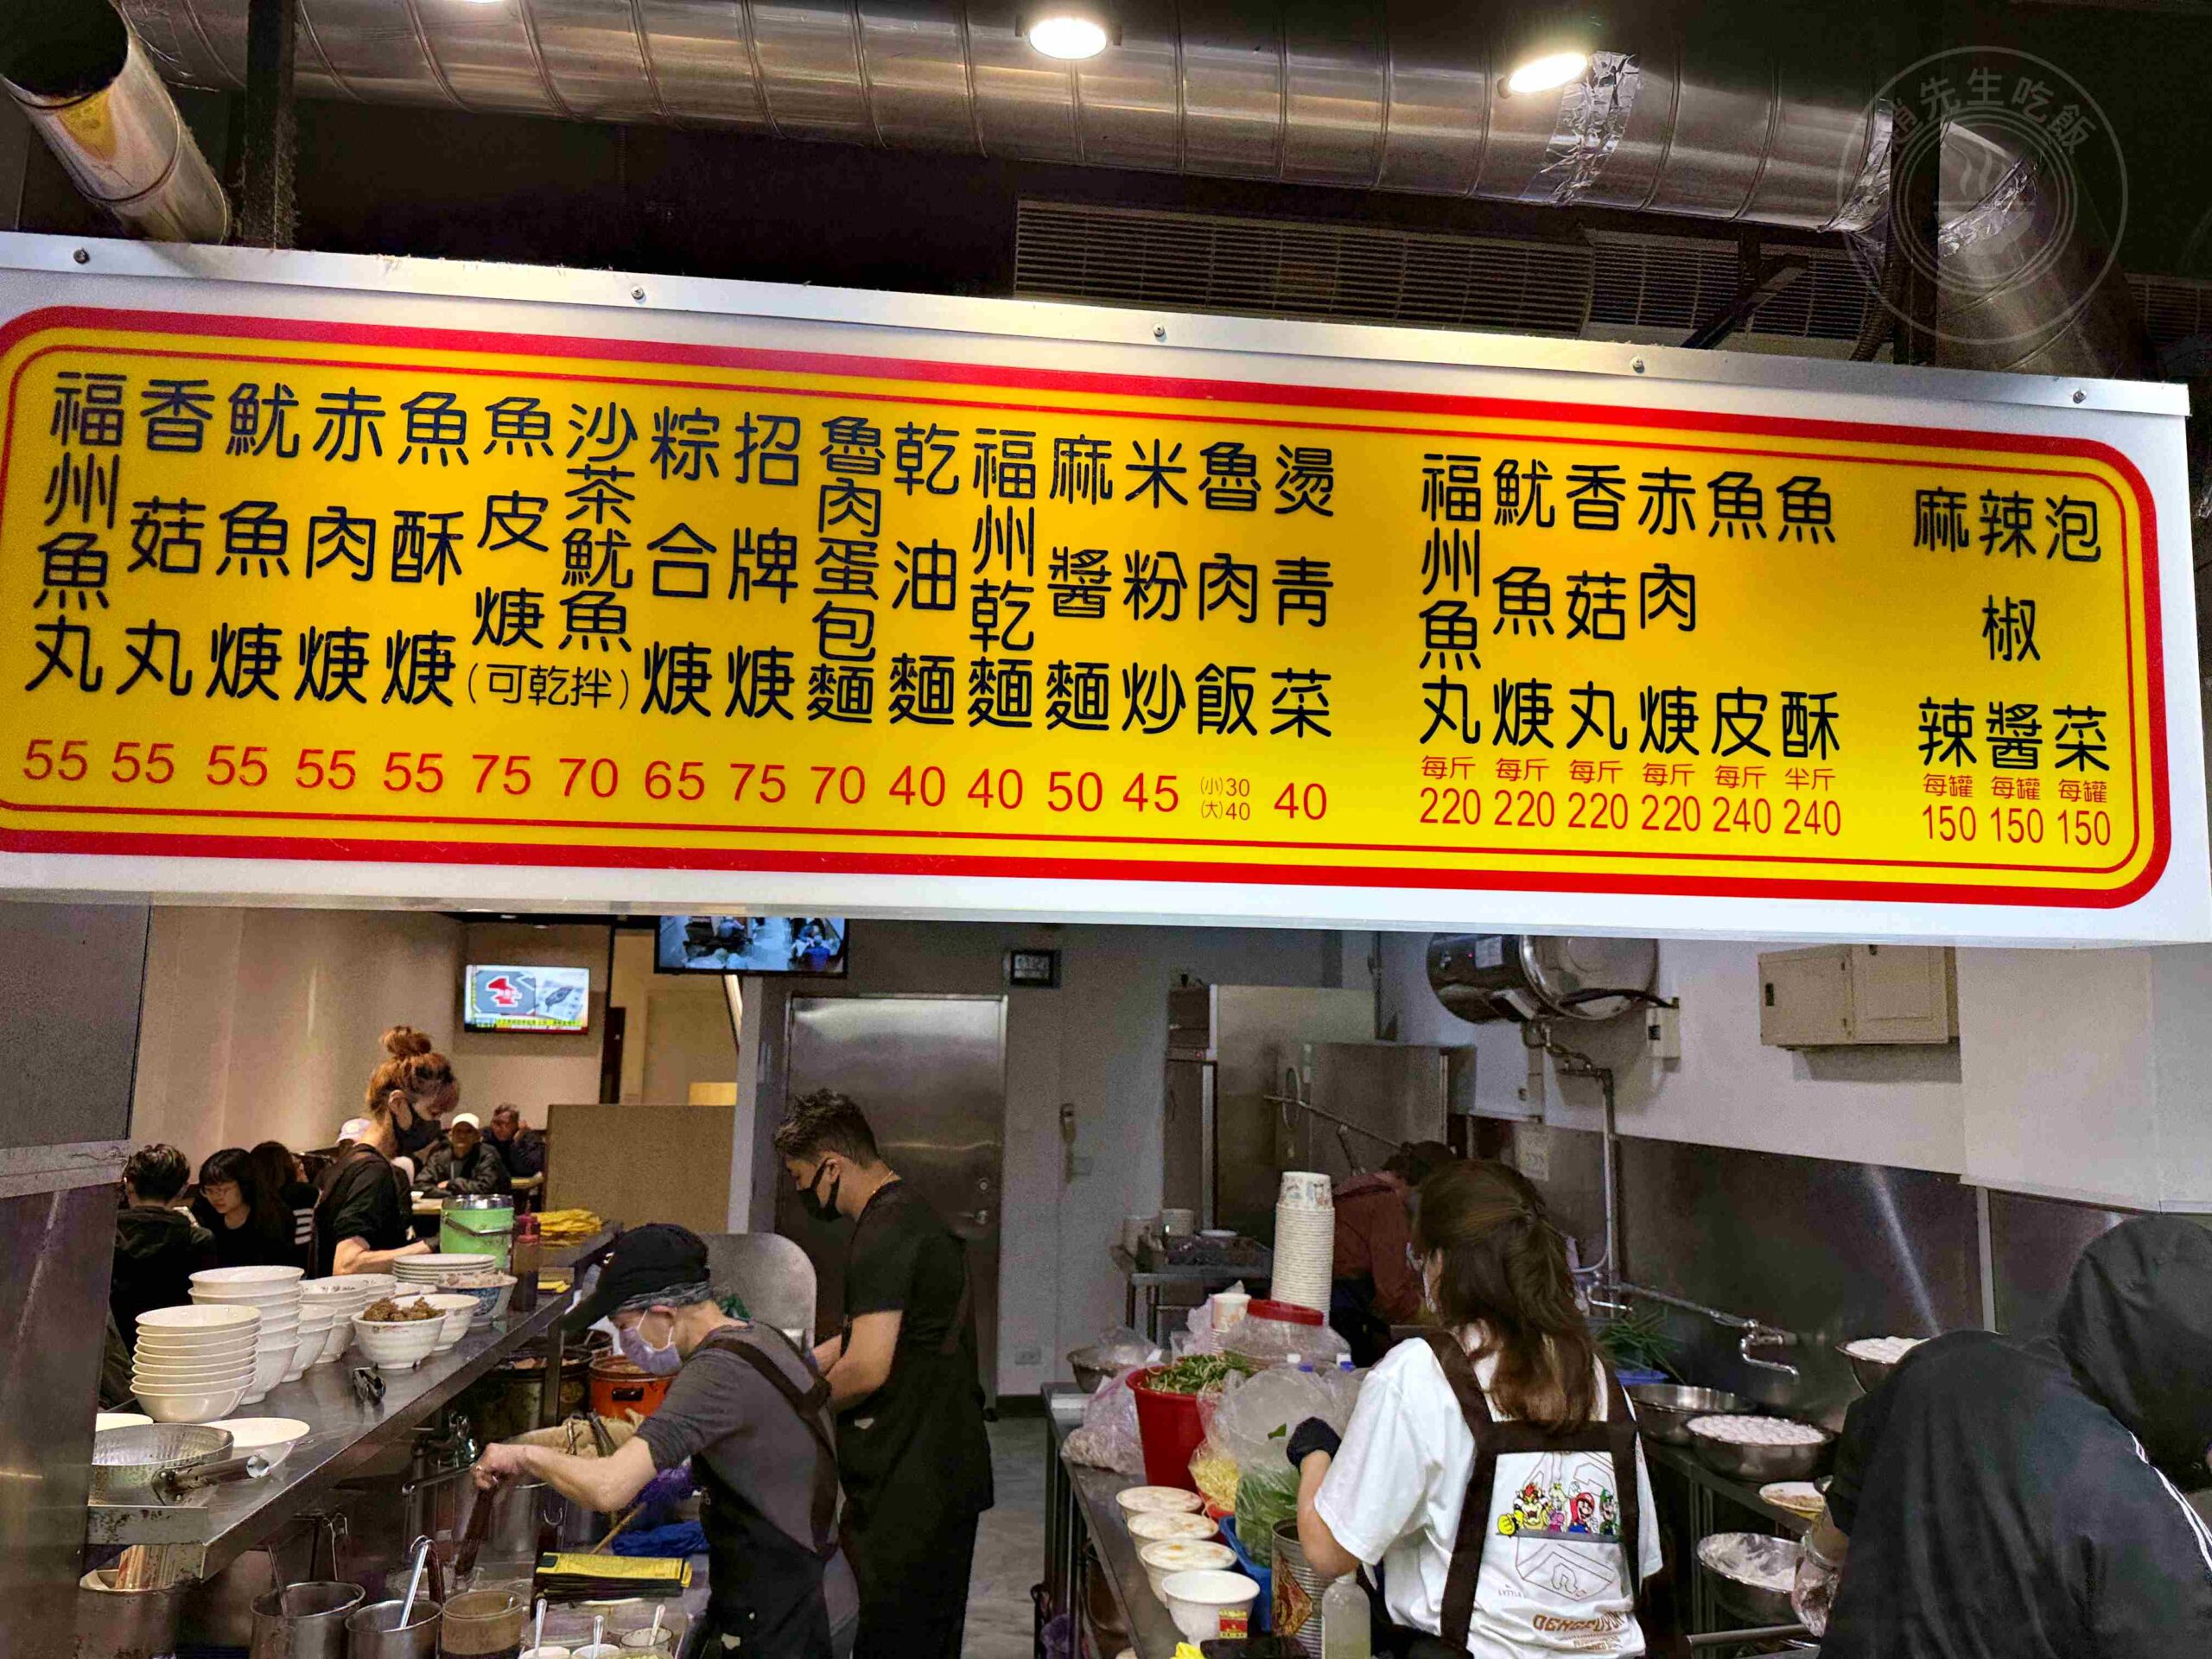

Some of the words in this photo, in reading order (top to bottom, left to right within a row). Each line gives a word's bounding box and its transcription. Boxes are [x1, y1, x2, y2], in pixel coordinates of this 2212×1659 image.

[468, 664, 628, 709] (可乾拌)
[22, 739, 87, 781] 55
[111, 741, 175, 784] 55
[207, 745, 268, 786] 55
[296, 748, 355, 790] 55
[384, 752, 443, 793] 55
[473, 754, 531, 795] 75
[559, 758, 618, 798] 70
[645, 760, 705, 801] 65
[730, 763, 785, 803] 75
[810, 766, 865, 804] 70
[889, 766, 945, 807] 40
[968, 769, 1022, 809] 40
[1048, 772, 1103, 811] 50
[1123, 772, 1178, 812] 45
[1423, 757, 1474, 779] 每斤
[1497, 758, 1548, 781] 每斤
[1570, 760, 1623, 784] 每斤
[1644, 764, 1694, 785] 每斤
[1716, 766, 1766, 788] 每斤
[1787, 769, 1834, 789] 半斤
[1924, 774, 1971, 797] 每罐
[1993, 776, 2038, 799] 每罐
[2060, 781, 2105, 802] 每罐
[1274, 783, 1326, 820] 40
[1421, 787, 1480, 824] 220
[1495, 790, 1554, 827] 220
[1568, 792, 1628, 830] 220
[1642, 795, 1700, 831] 220
[1713, 797, 1770, 833] 240
[1784, 799, 1840, 836] 240
[1923, 805, 1975, 841] 150
[1992, 808, 2043, 843] 150
[2059, 810, 2110, 845] 150
